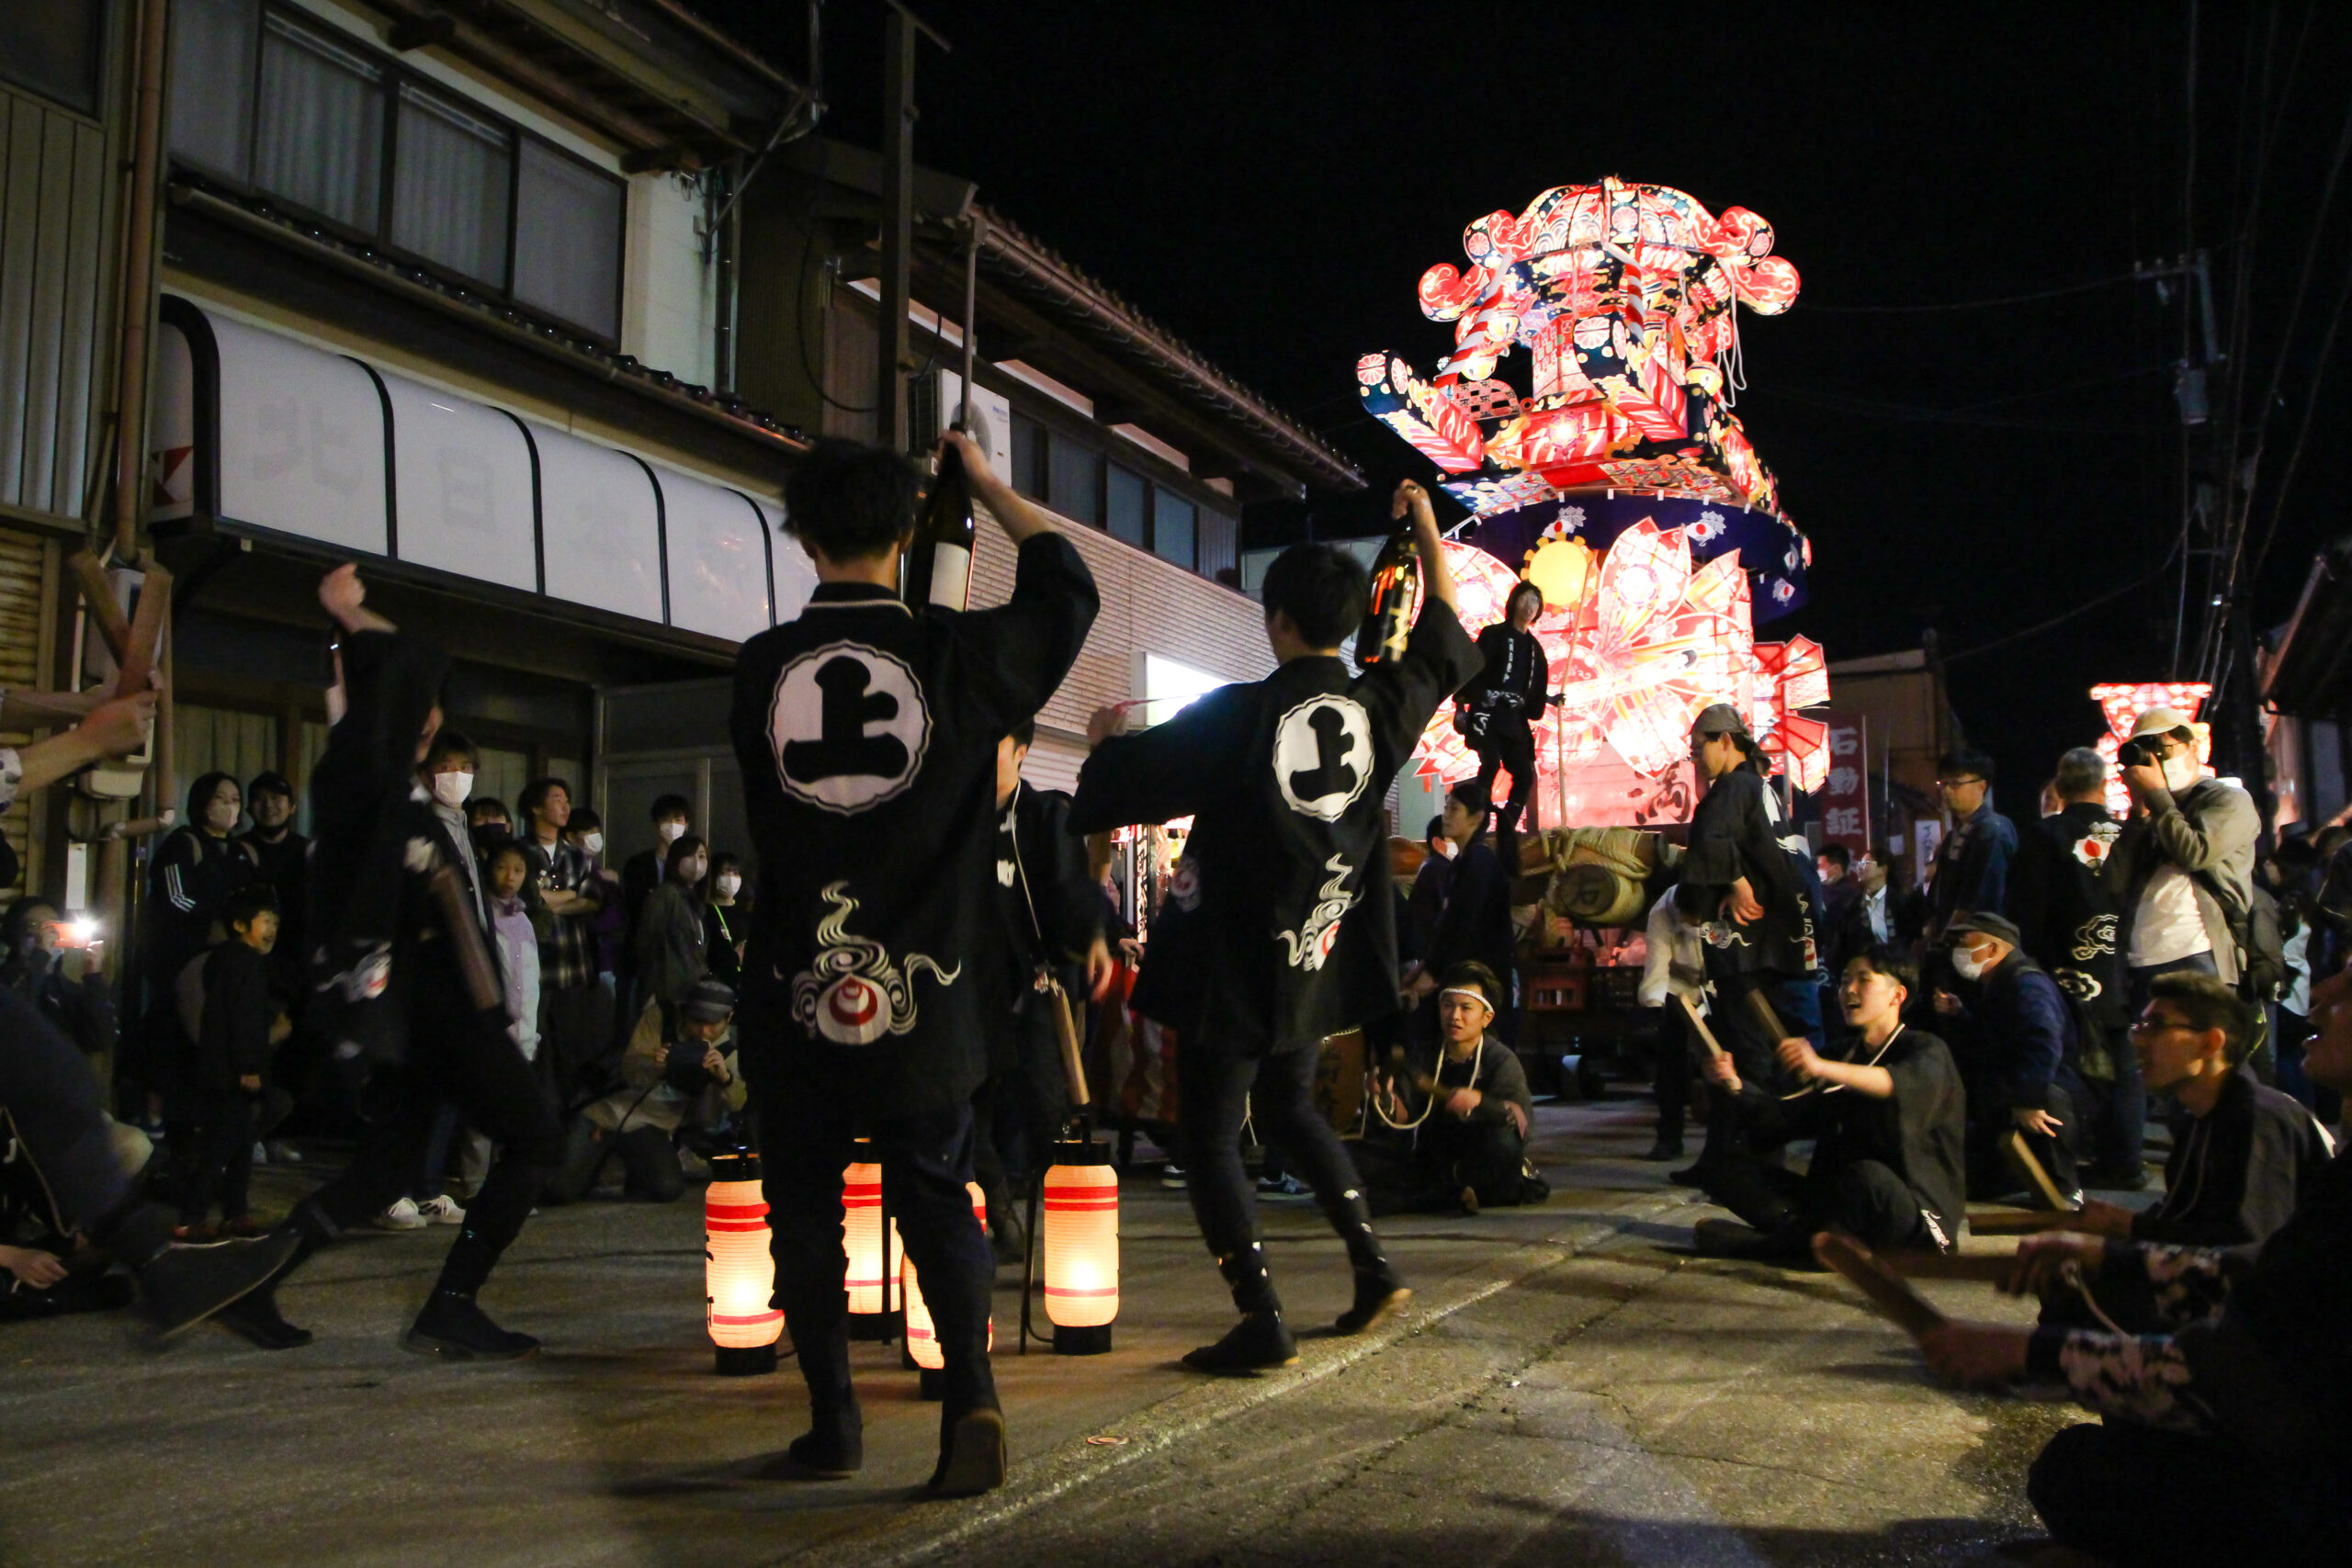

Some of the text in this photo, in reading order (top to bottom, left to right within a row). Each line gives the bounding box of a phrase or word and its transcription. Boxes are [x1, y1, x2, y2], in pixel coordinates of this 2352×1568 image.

[783, 656, 909, 784] 上
[1290, 705, 1357, 802] 上
[1826, 727, 1863, 880] 石動証
